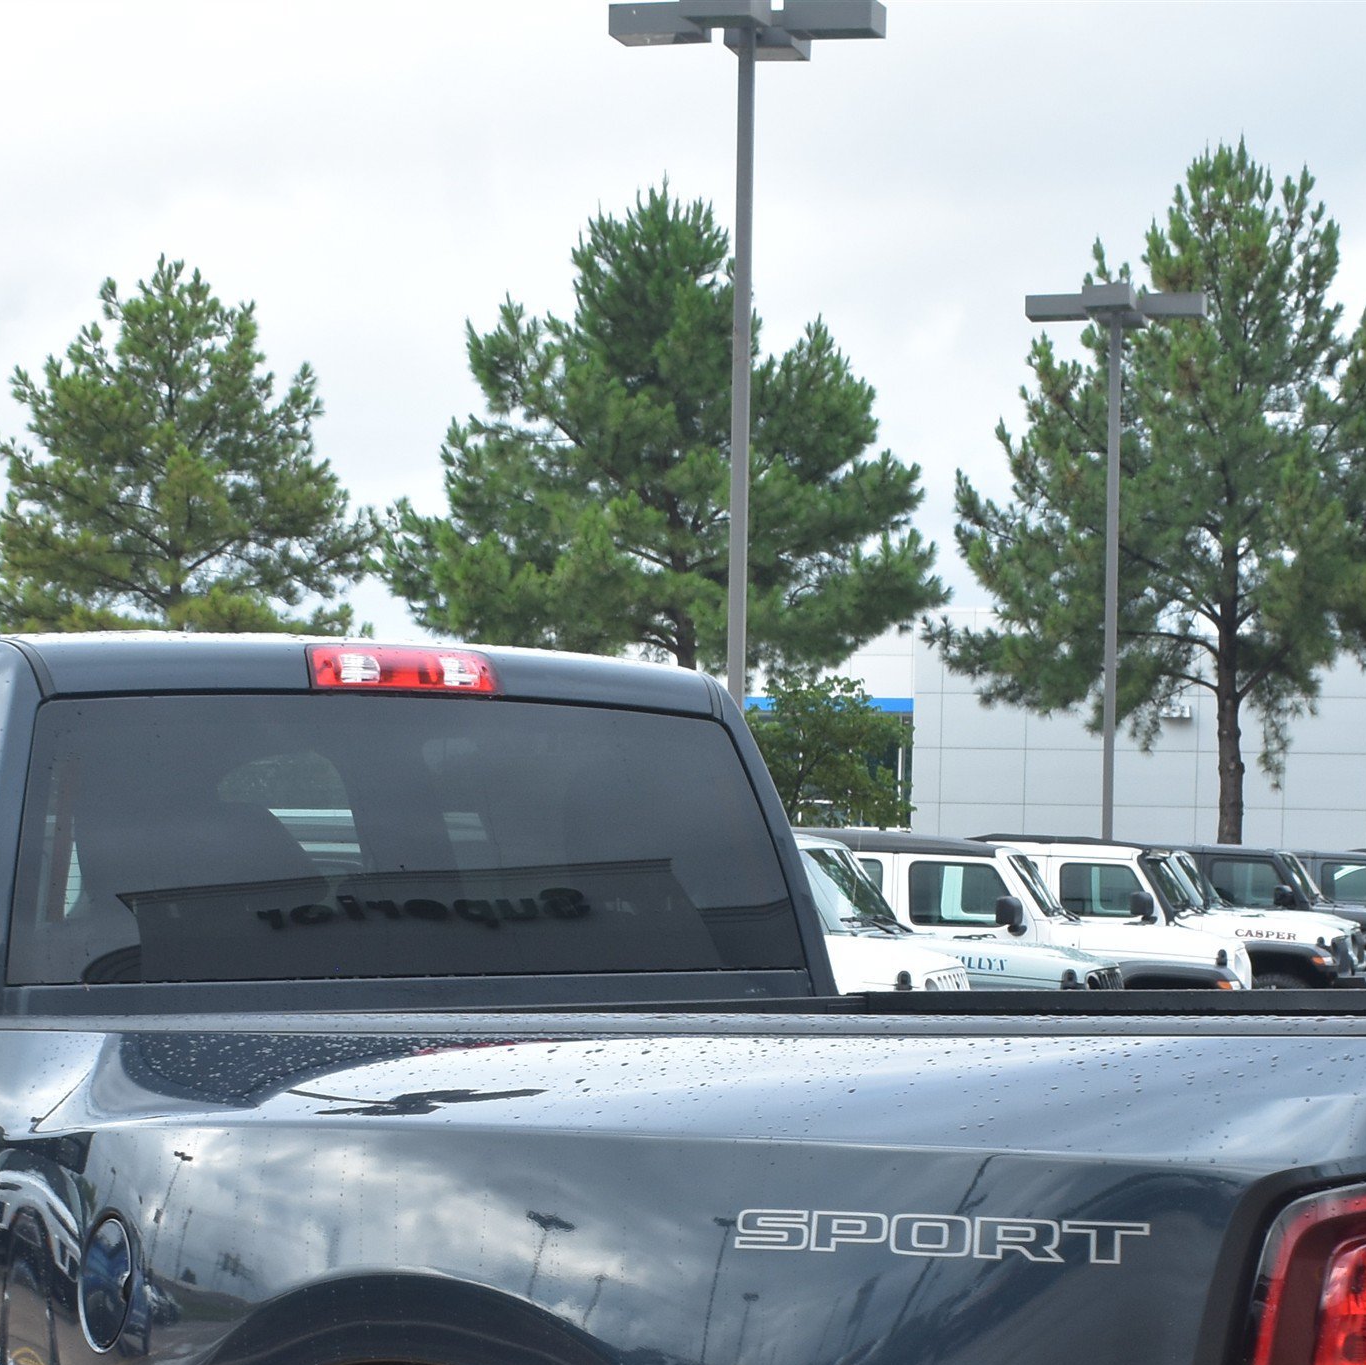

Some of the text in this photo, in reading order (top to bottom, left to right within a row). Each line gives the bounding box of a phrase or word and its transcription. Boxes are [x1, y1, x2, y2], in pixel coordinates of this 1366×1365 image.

[1235, 928, 1297, 941] CASPER
[955, 956, 1008, 971] ILLYS
[735, 1208, 1150, 1264] SPORT
